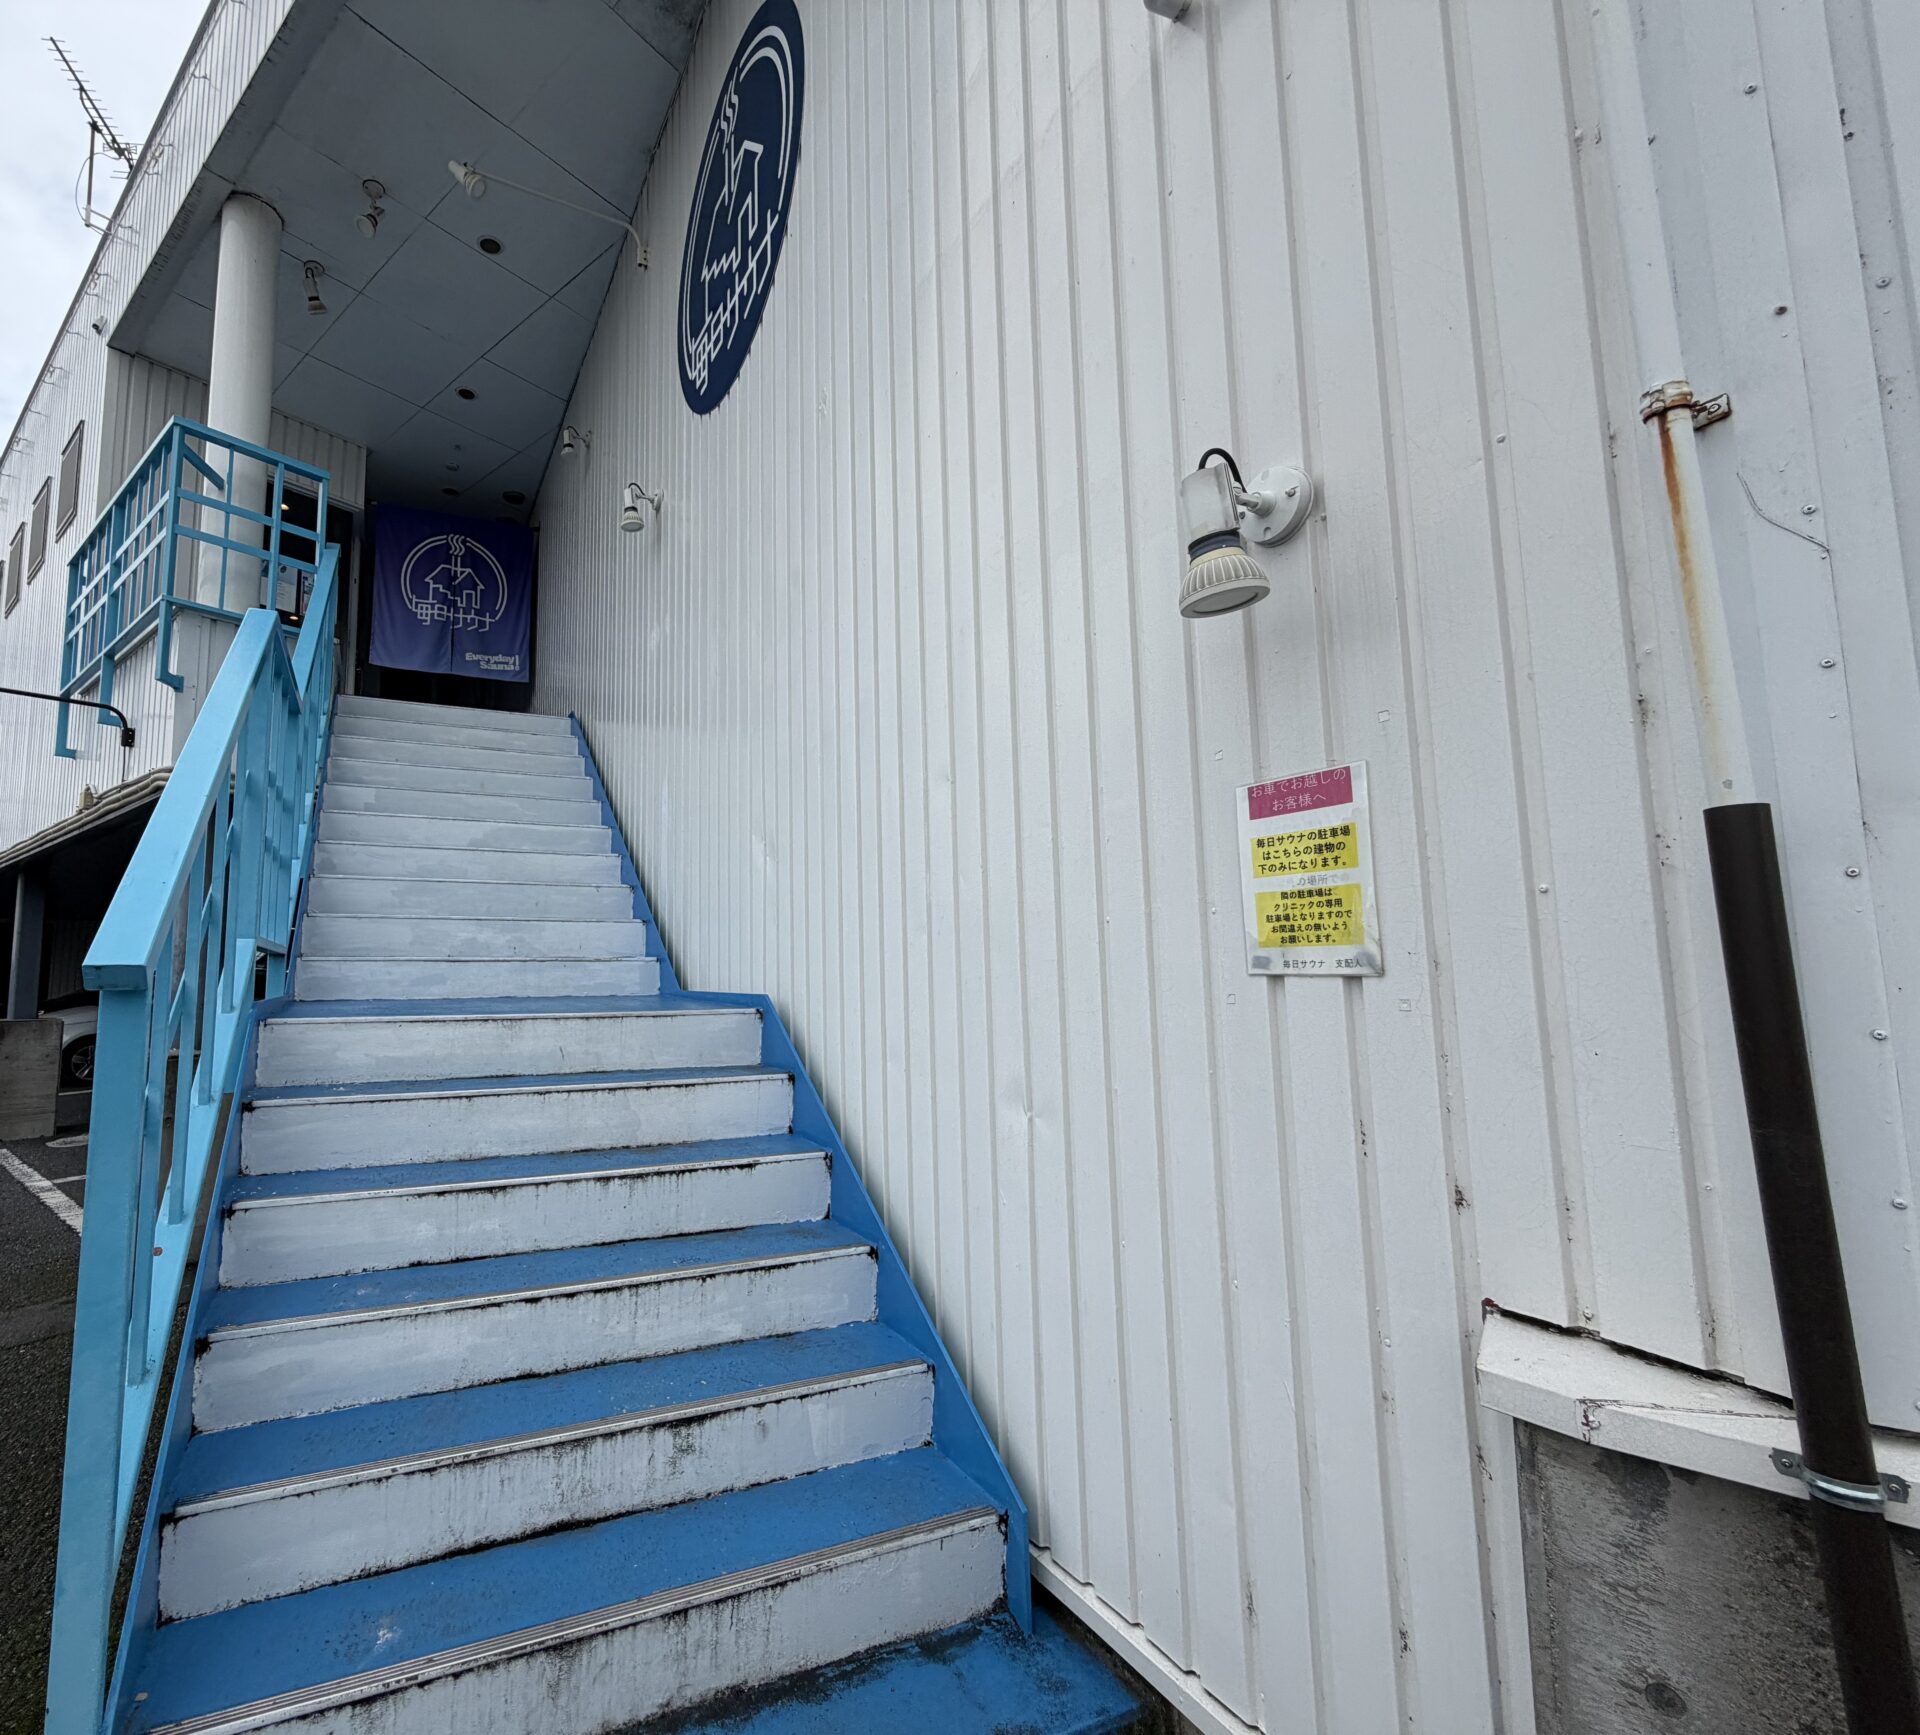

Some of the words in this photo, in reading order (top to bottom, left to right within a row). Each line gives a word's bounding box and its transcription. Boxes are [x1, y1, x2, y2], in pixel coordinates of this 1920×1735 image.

[1251, 768, 1346, 798] お車でお越しの
[1272, 793, 1327, 812] お客様へ
[1256, 825, 1351, 849] 毎日サウナの駐車場
[1262, 841, 1346, 861] はこちらの建物の
[1258, 855, 1347, 875] 下のみになります。
[1280, 888, 1333, 901] 隣の駐車場は
[1274, 898, 1343, 912] クリニックの専用
[1265, 909, 1353, 923] 駐車場となりますので
[1271, 921, 1348, 934] お間違えの無いよう
[1280, 934, 1337, 945] お願いします。
[1283, 959, 1326, 969] 毎日サウナ
[1335, 958, 1363, 969] 支配人
